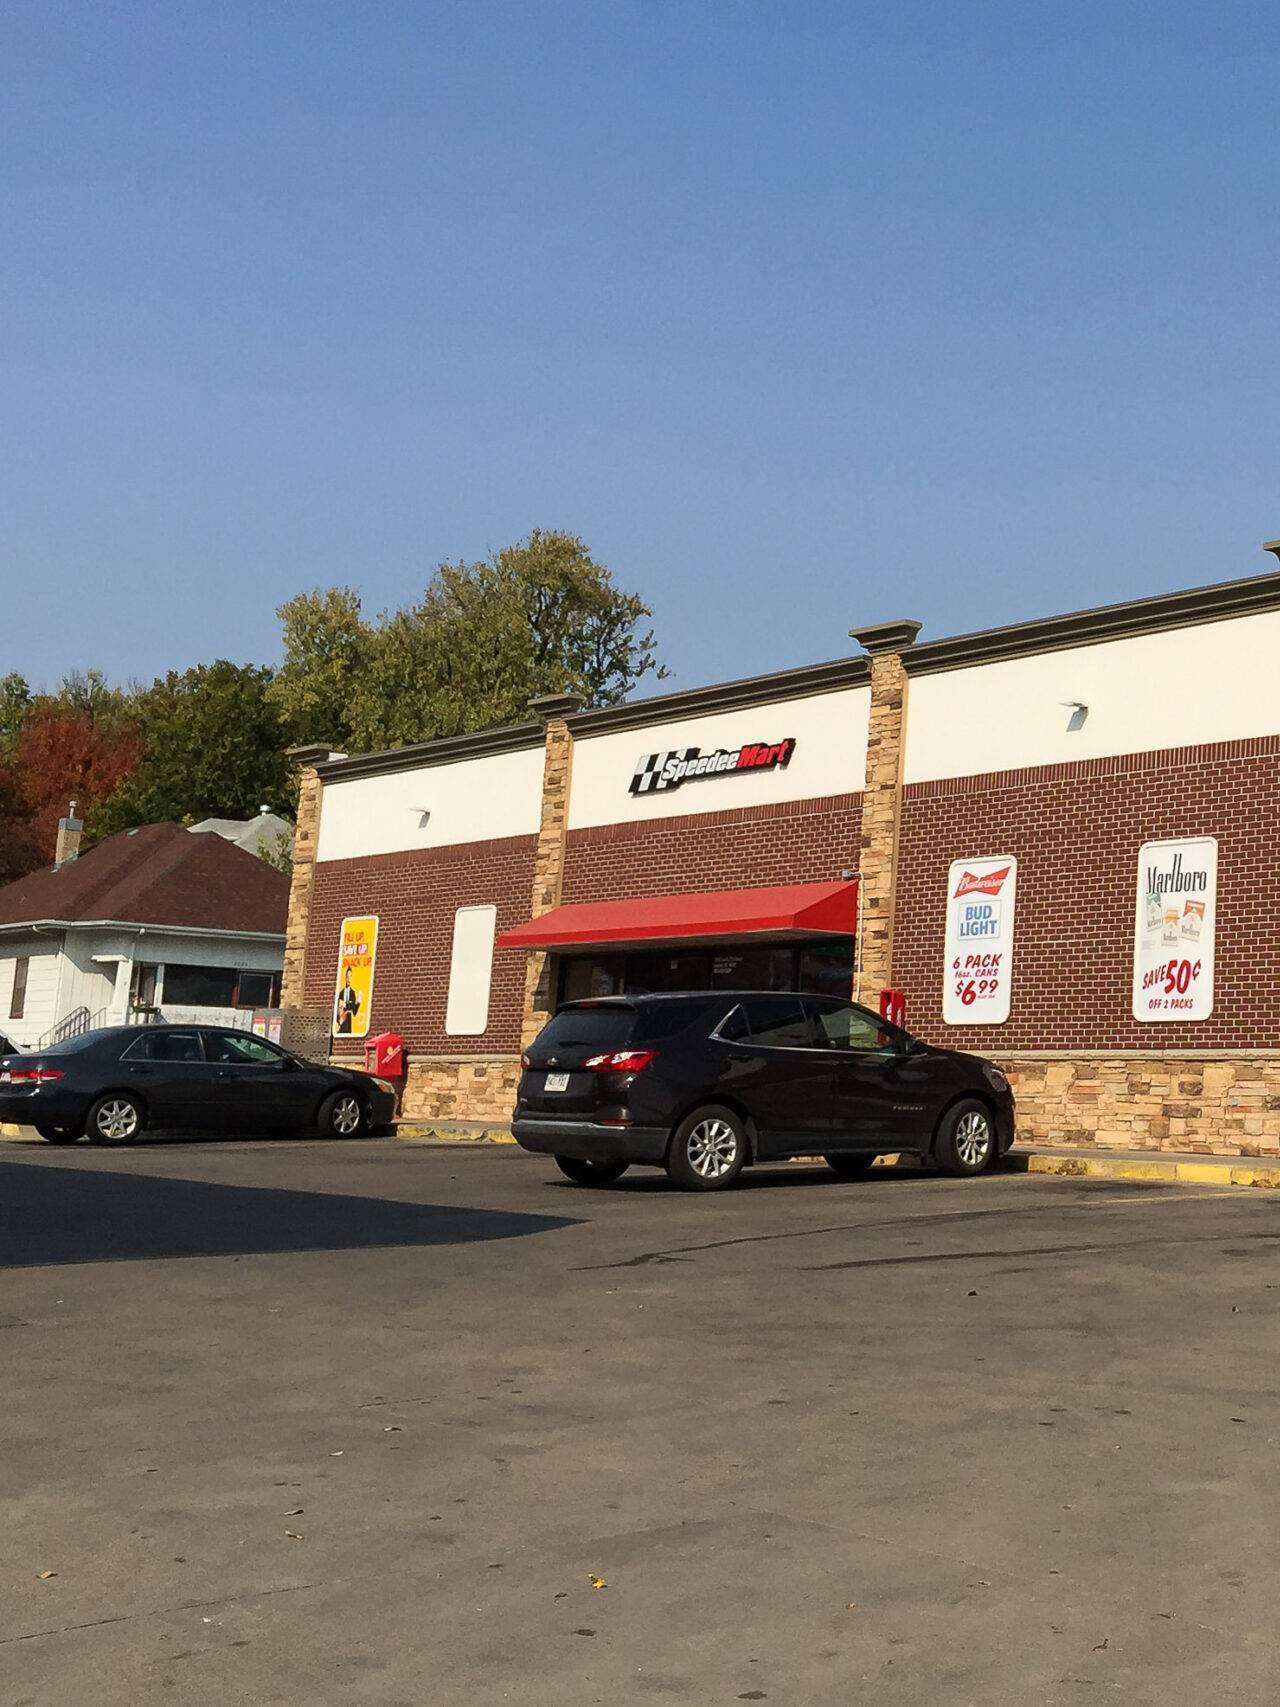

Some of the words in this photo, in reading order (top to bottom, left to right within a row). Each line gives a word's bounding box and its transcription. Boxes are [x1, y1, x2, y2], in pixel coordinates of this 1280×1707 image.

[1146, 853, 1207, 894] Marlboro
[965, 905, 992, 920] BUD
[960, 920, 997, 936] LIGHT
[953, 957, 960, 969] 6
[965, 953, 1002, 968] PACK
[975, 968, 999, 977] CANS
[1142, 964, 1167, 990] SAVE
[1148, 998, 1162, 1009] OFF
[1163, 999, 1169, 1009] 2
[1170, 998, 1193, 1009] PACKS
